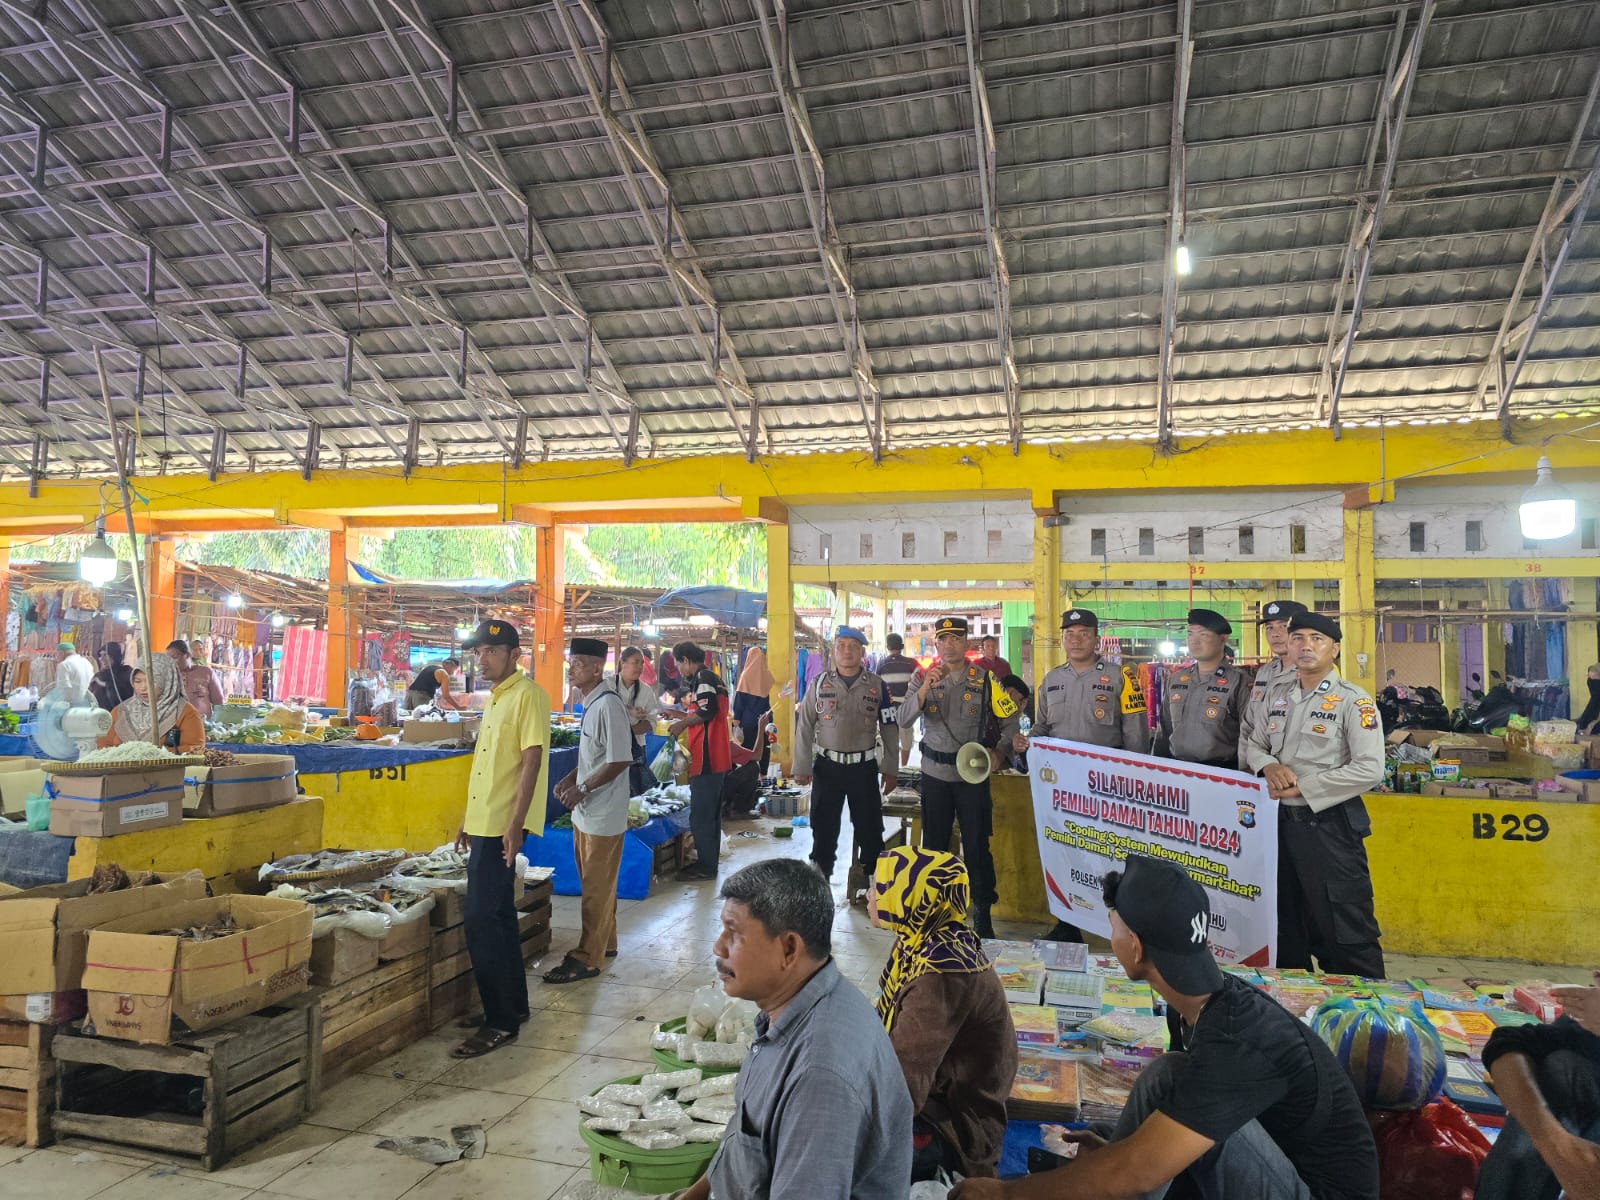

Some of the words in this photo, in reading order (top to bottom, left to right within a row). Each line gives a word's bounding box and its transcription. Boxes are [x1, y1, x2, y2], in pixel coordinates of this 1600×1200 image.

[1092, 684, 1114, 692] POLRI
[881, 706, 897, 724] PR
[1311, 711, 1337, 721] POLRI
[1087, 769, 1188, 812] SILATURAHMI
[1052, 788, 1098, 818] PEMILU
[1101, 799, 1144, 831] DAMAI
[1147, 810, 1196, 843] TAHUN
[1199, 822, 1240, 853] 2024
[1044, 826, 1076, 847] Pemilu
[1107, 832, 1148, 854] System
[1149, 842, 1228, 875] Mewujudkan
[1070, 868, 1098, 887] POLSEK
[1209, 912, 1226, 930] HU
